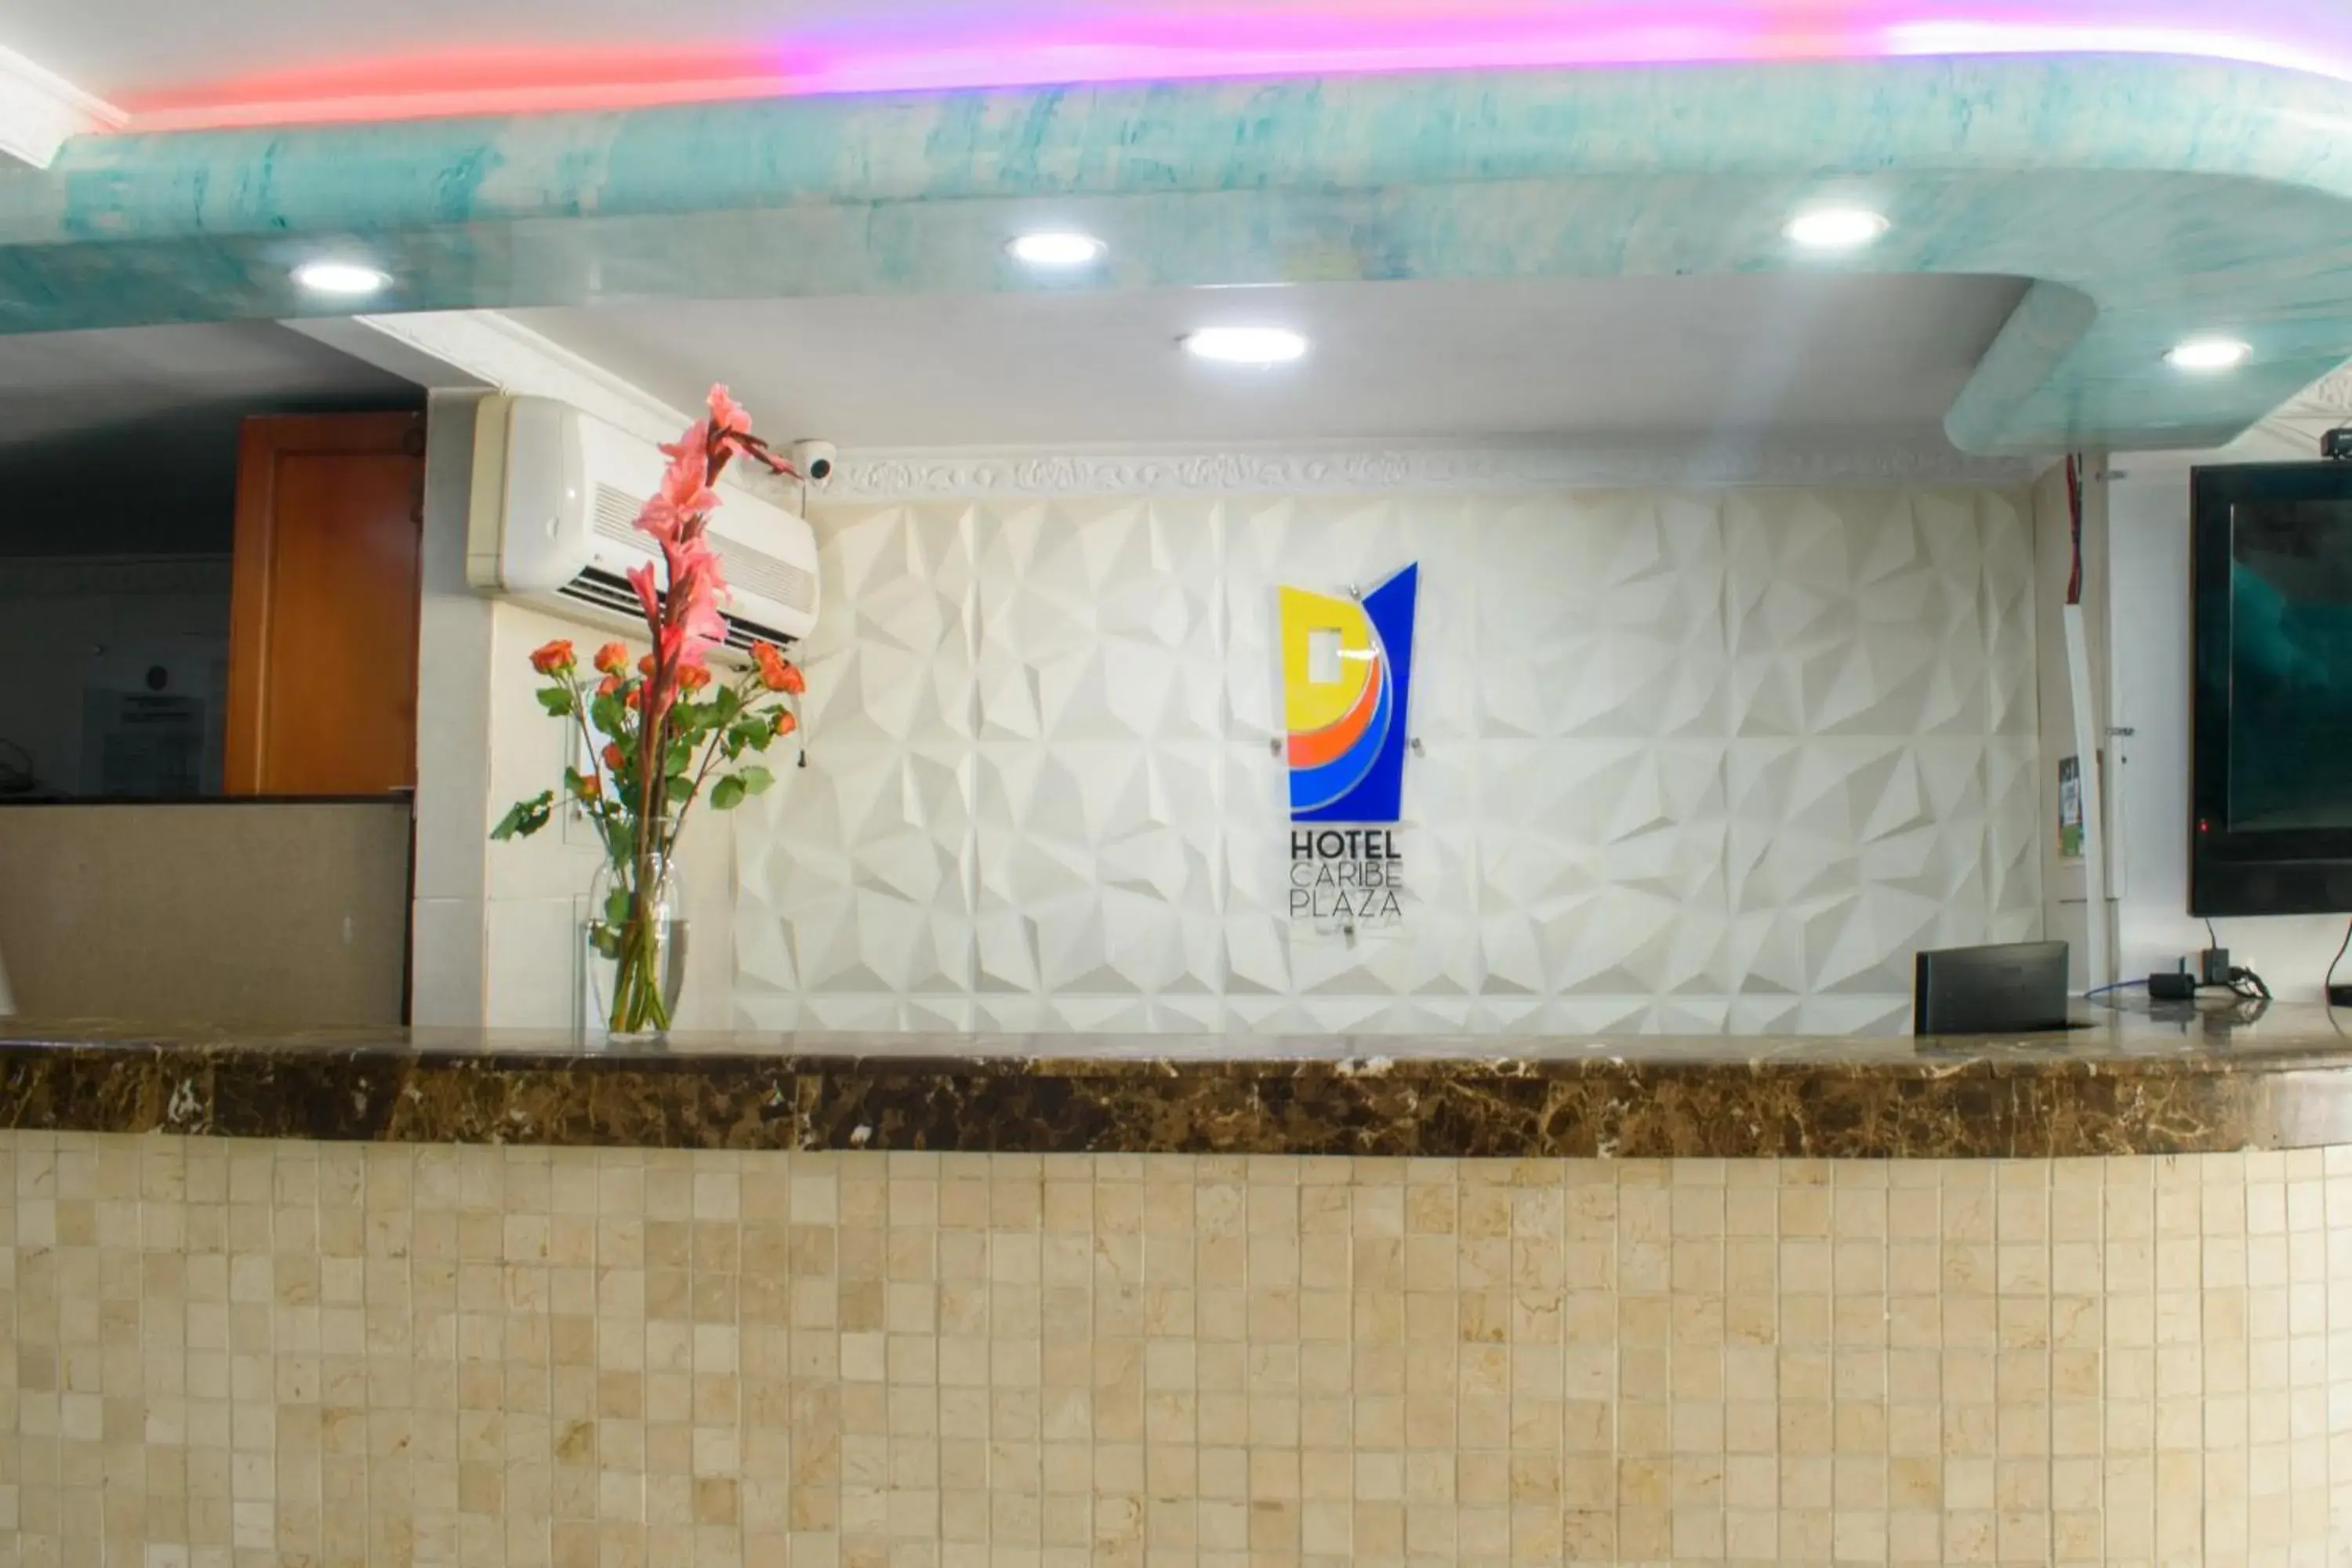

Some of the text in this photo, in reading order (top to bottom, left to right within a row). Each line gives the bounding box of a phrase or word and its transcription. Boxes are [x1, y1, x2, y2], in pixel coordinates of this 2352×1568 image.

[1290, 830, 1402, 859] HOTEL
[1290, 862, 1403, 887] CARIBE
[1290, 889, 1402, 916] PLAZA
